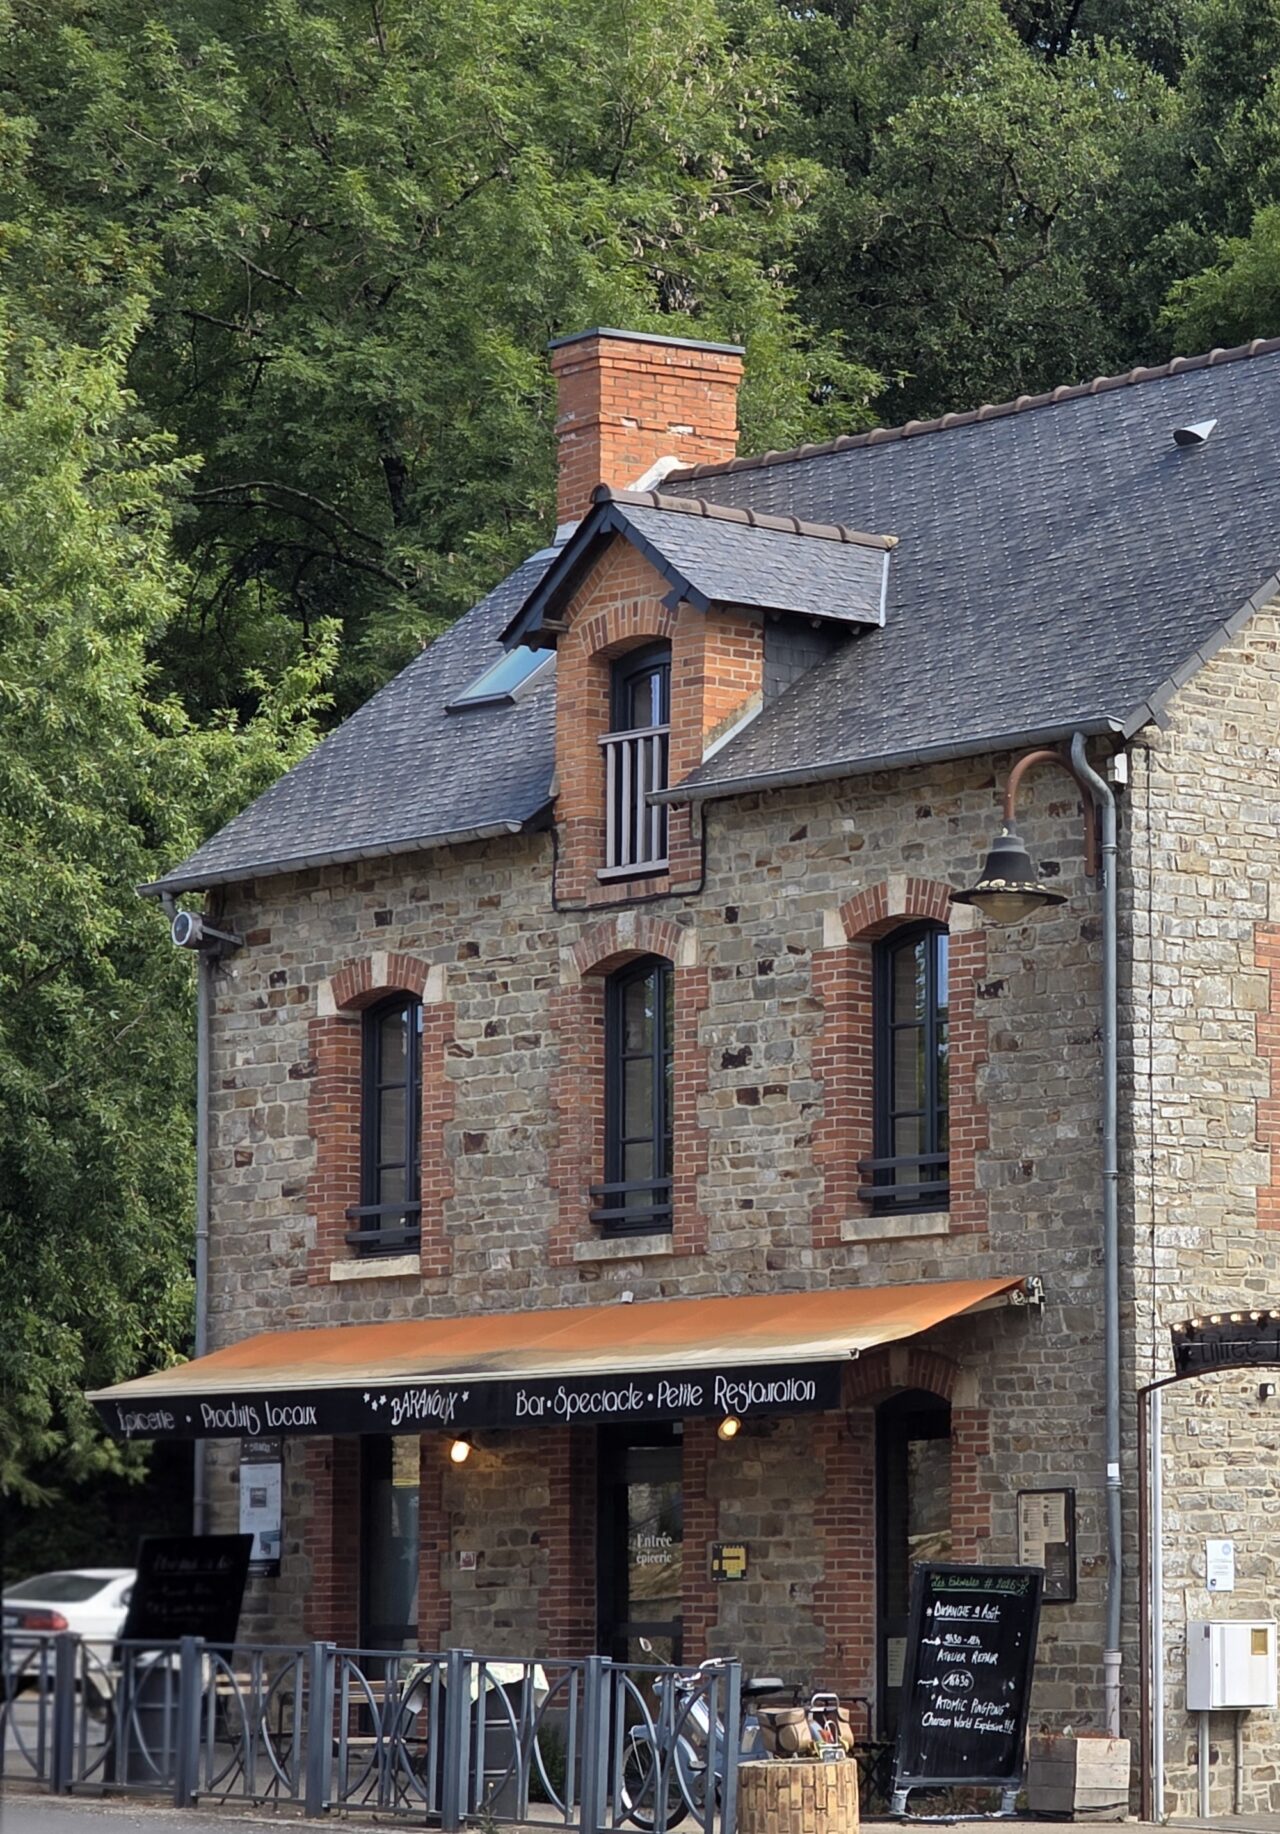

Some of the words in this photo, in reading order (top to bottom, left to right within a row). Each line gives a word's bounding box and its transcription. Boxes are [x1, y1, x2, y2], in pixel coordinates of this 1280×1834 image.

[1199, 1333, 1263, 1363] Entrée
[390, 1388, 458, 1426] BARANOUX
[515, 1389, 546, 1417] Bar
[553, 1382, 644, 1421] Spectacle
[657, 1379, 703, 1408] Petite
[714, 1375, 816, 1415] Restauration
[200, 1402, 260, 1436] Produits
[266, 1400, 317, 1427] Locaux
[636, 1531, 673, 1548] Entrée
[636, 1550, 672, 1567] épicerie
